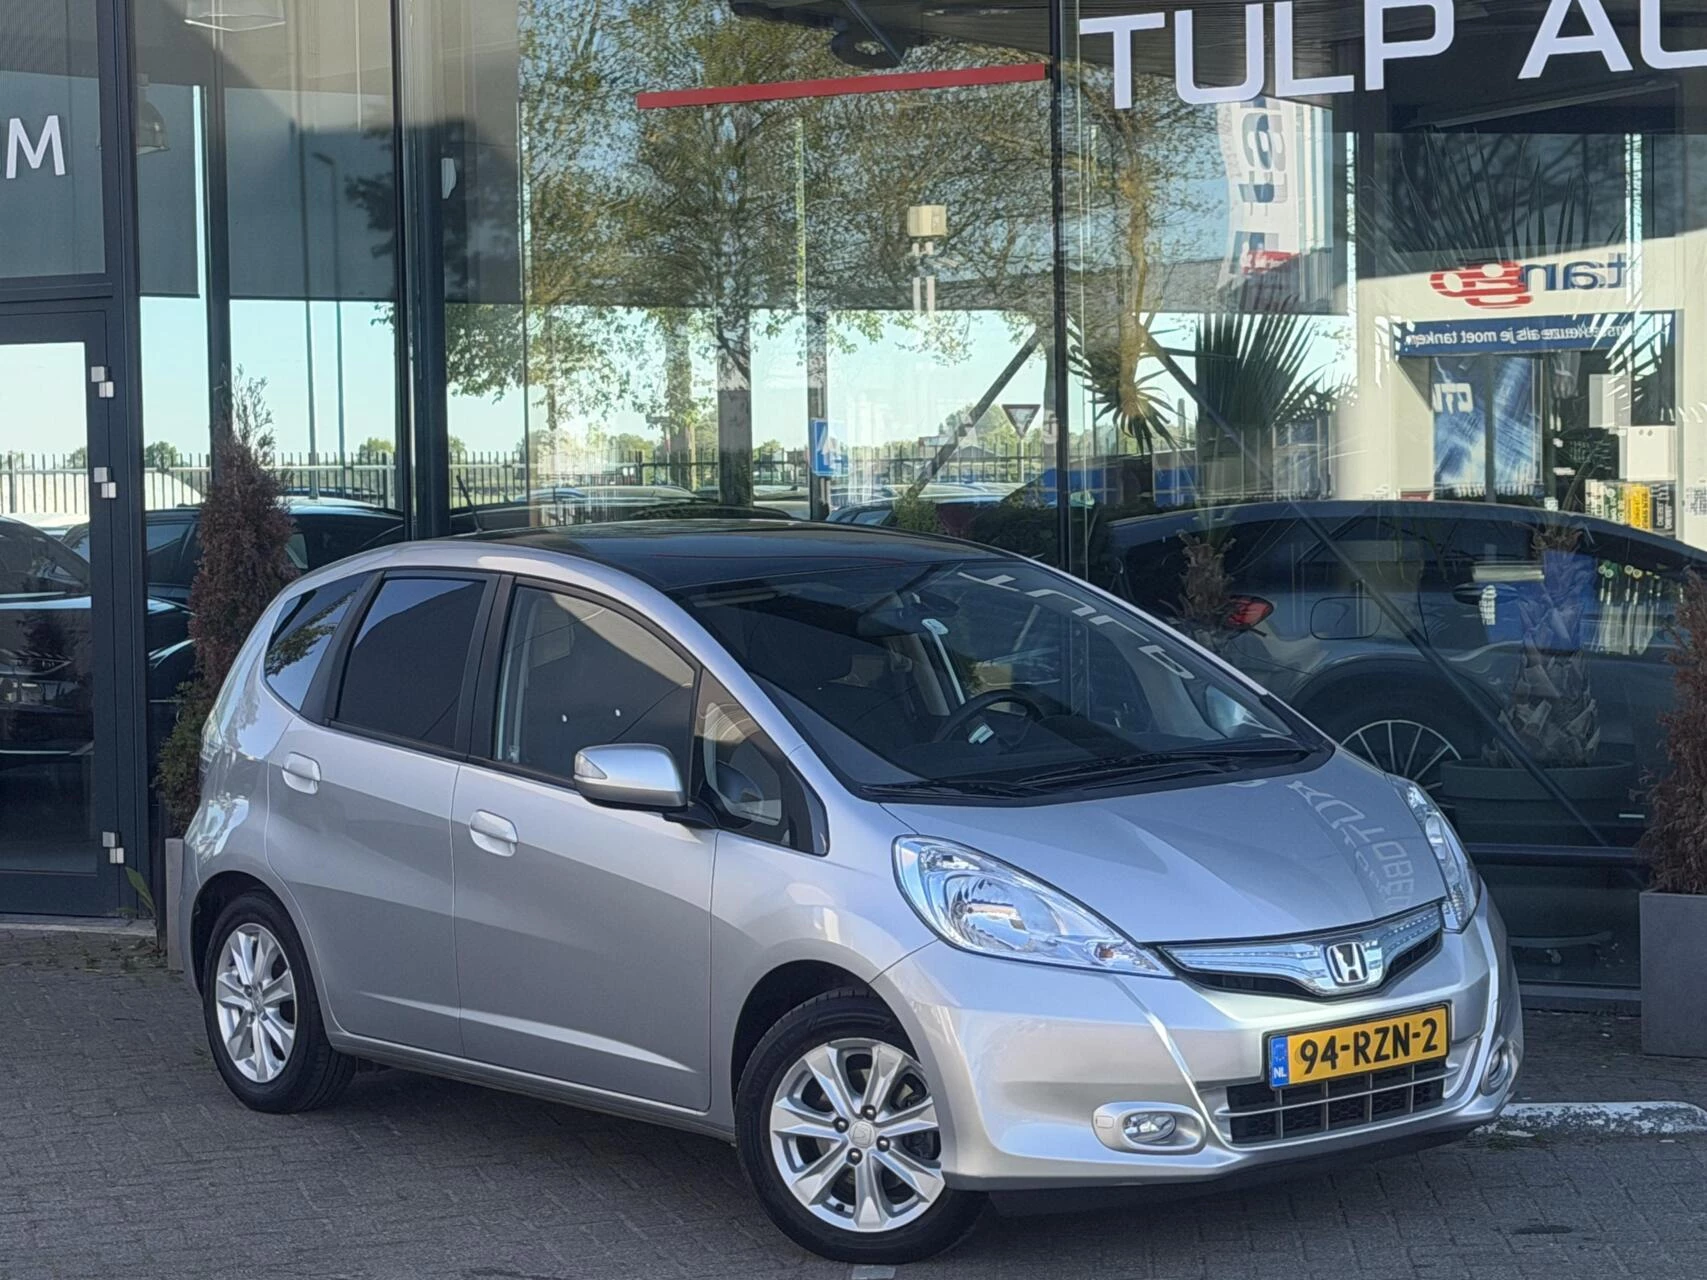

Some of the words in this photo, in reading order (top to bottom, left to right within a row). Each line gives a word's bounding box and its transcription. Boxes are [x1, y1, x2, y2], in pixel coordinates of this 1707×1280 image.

[1079, 0, 1454, 109] TULP
[6, 115, 65, 178] M
[1273, 1067, 1287, 1079] NL
[1299, 1017, 1439, 1075] 94-RZN-2
